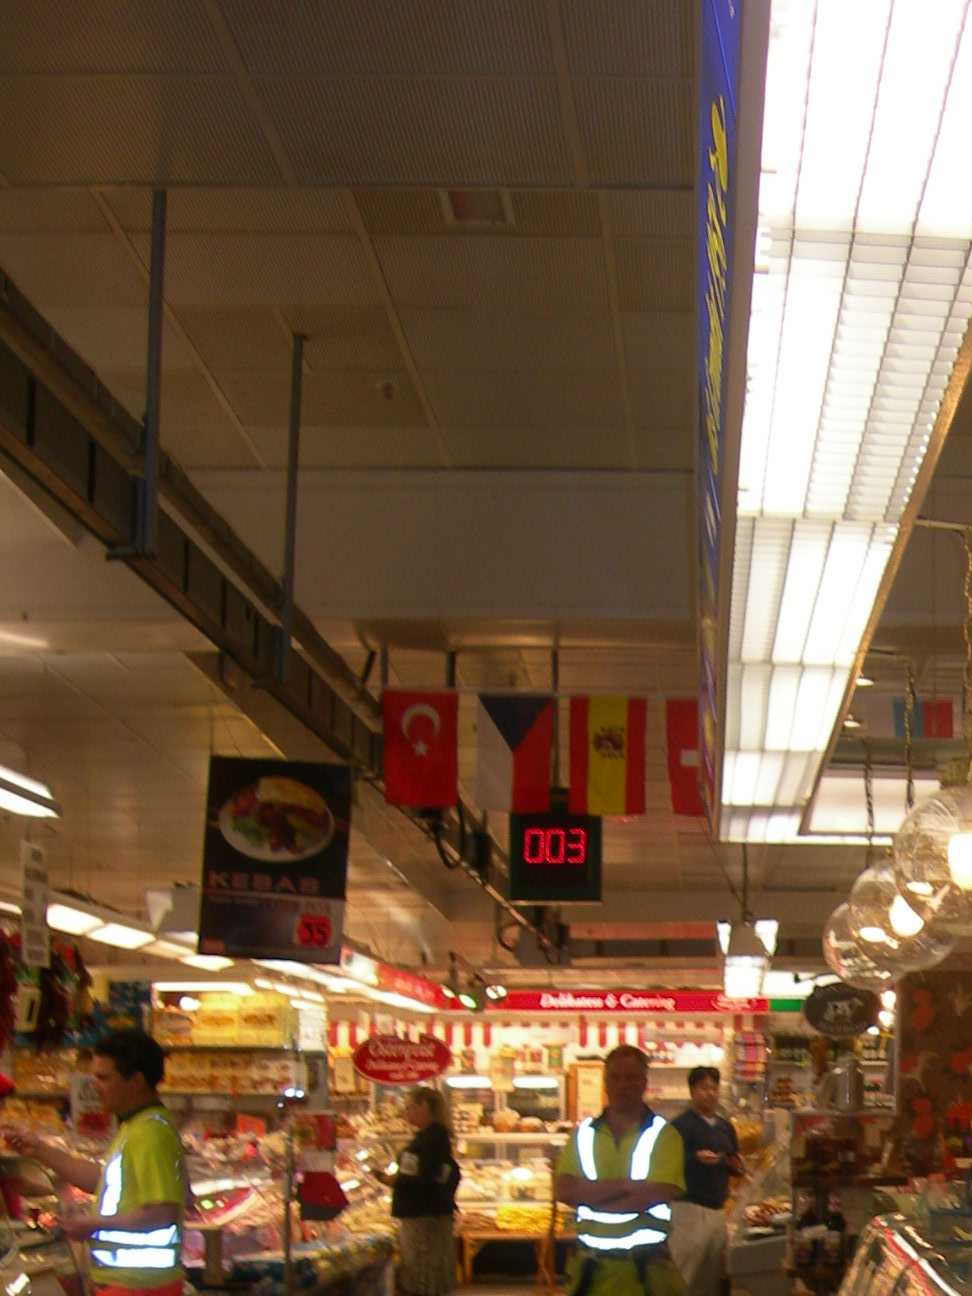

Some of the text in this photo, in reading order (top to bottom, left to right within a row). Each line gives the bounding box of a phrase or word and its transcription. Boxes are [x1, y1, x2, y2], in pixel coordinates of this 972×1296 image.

[523, 828, 586, 863] 003
[207, 871, 321, 895] KEBAB
[620, 993, 676, 1010] Catering
